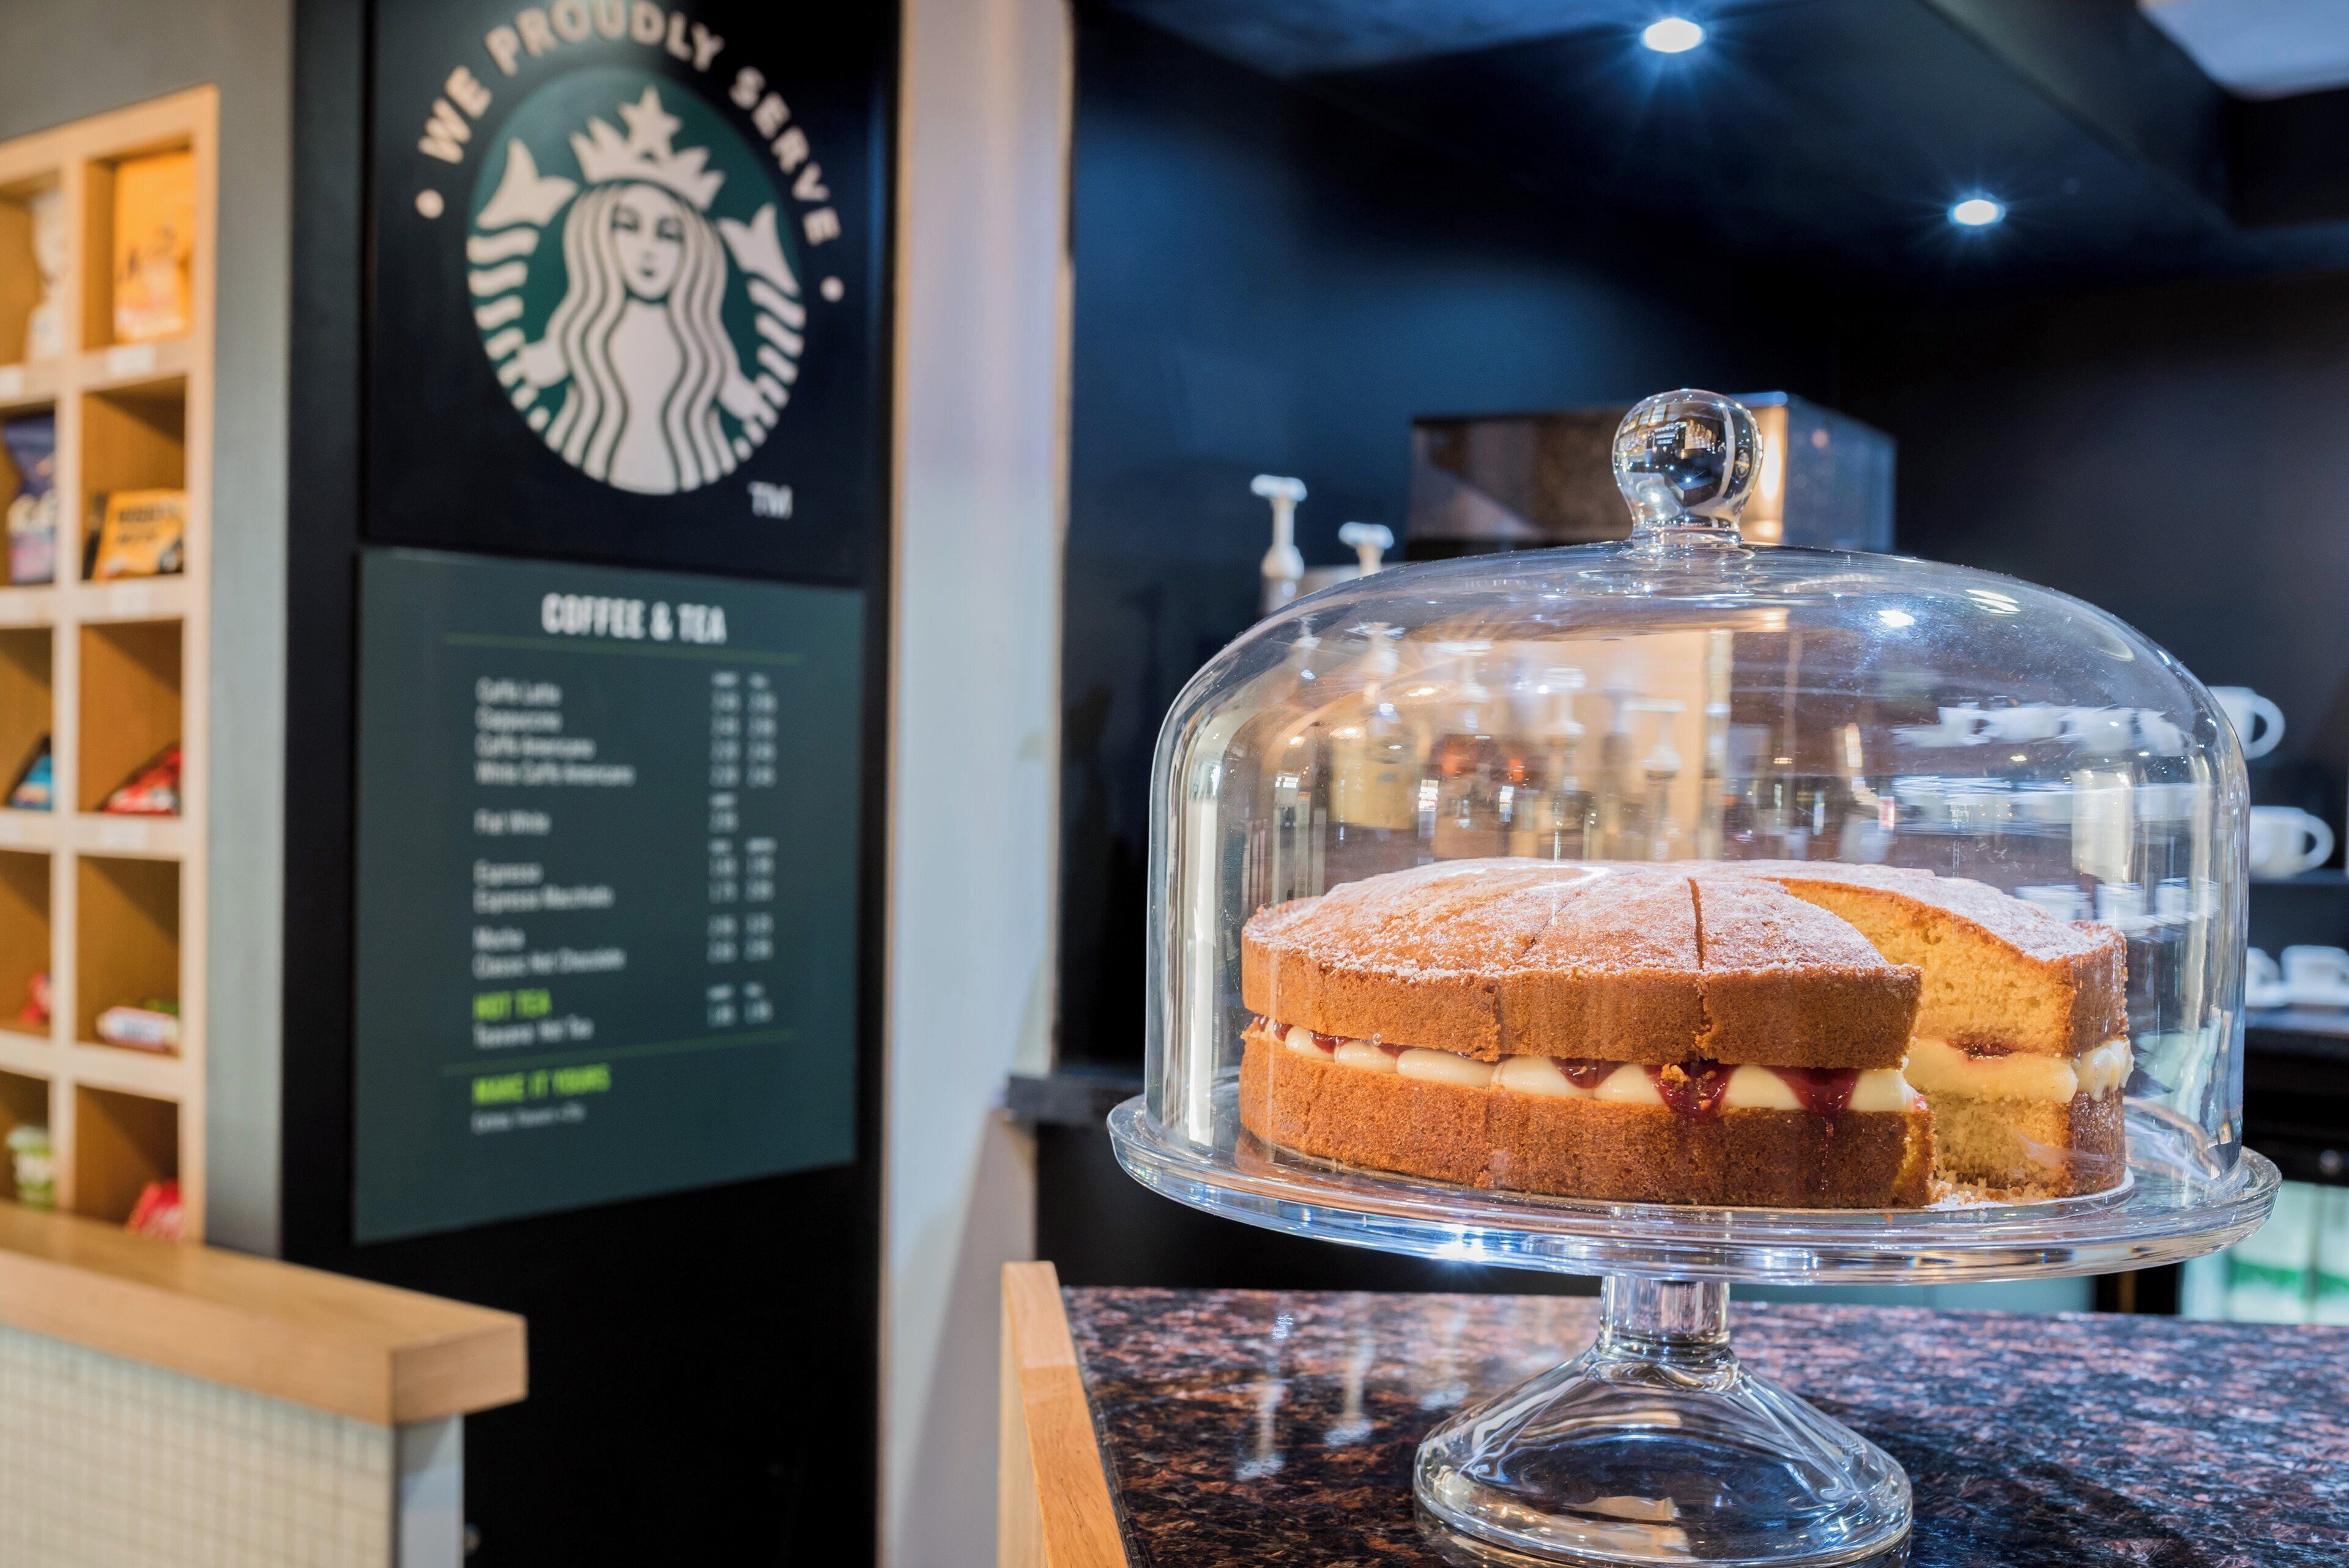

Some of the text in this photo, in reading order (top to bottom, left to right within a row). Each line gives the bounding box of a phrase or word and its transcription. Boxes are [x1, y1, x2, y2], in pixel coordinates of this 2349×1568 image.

[418, 0, 842, 246] WE PROUDLY SERVE
[542, 592, 727, 644] COFFEE & TEA
[473, 989, 552, 1020] HOT TEA
